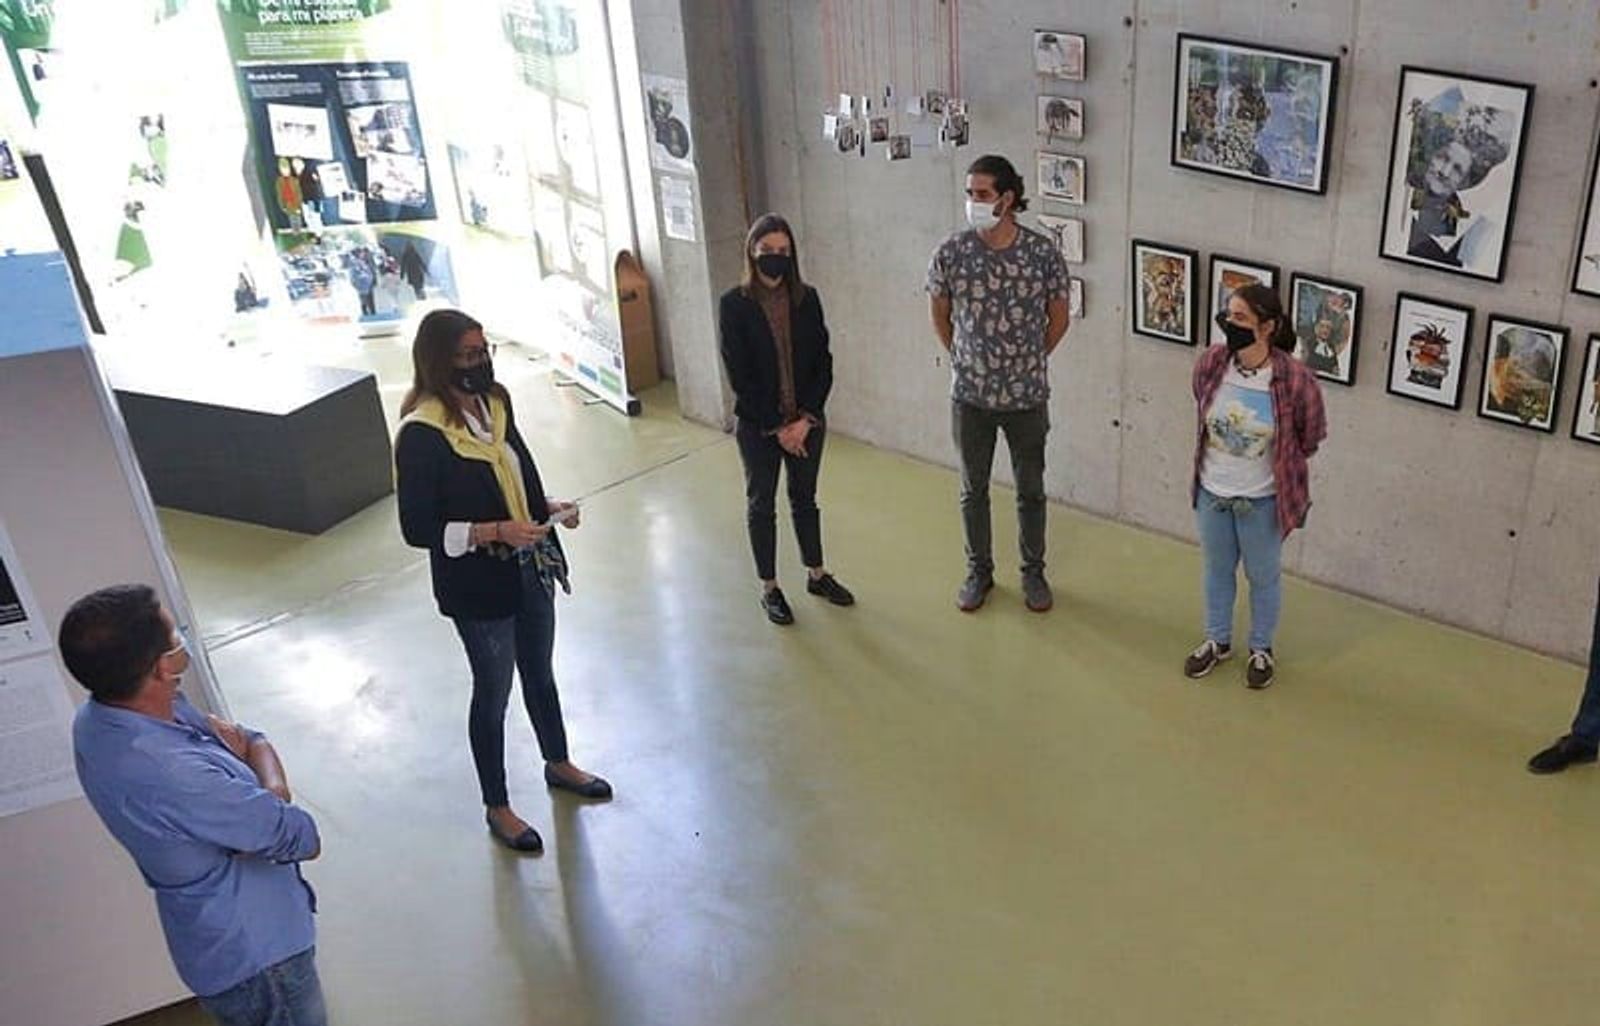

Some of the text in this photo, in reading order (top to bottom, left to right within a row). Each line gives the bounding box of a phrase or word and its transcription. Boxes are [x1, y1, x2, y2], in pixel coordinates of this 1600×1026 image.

[258, 6, 361, 26] para mi planeta
